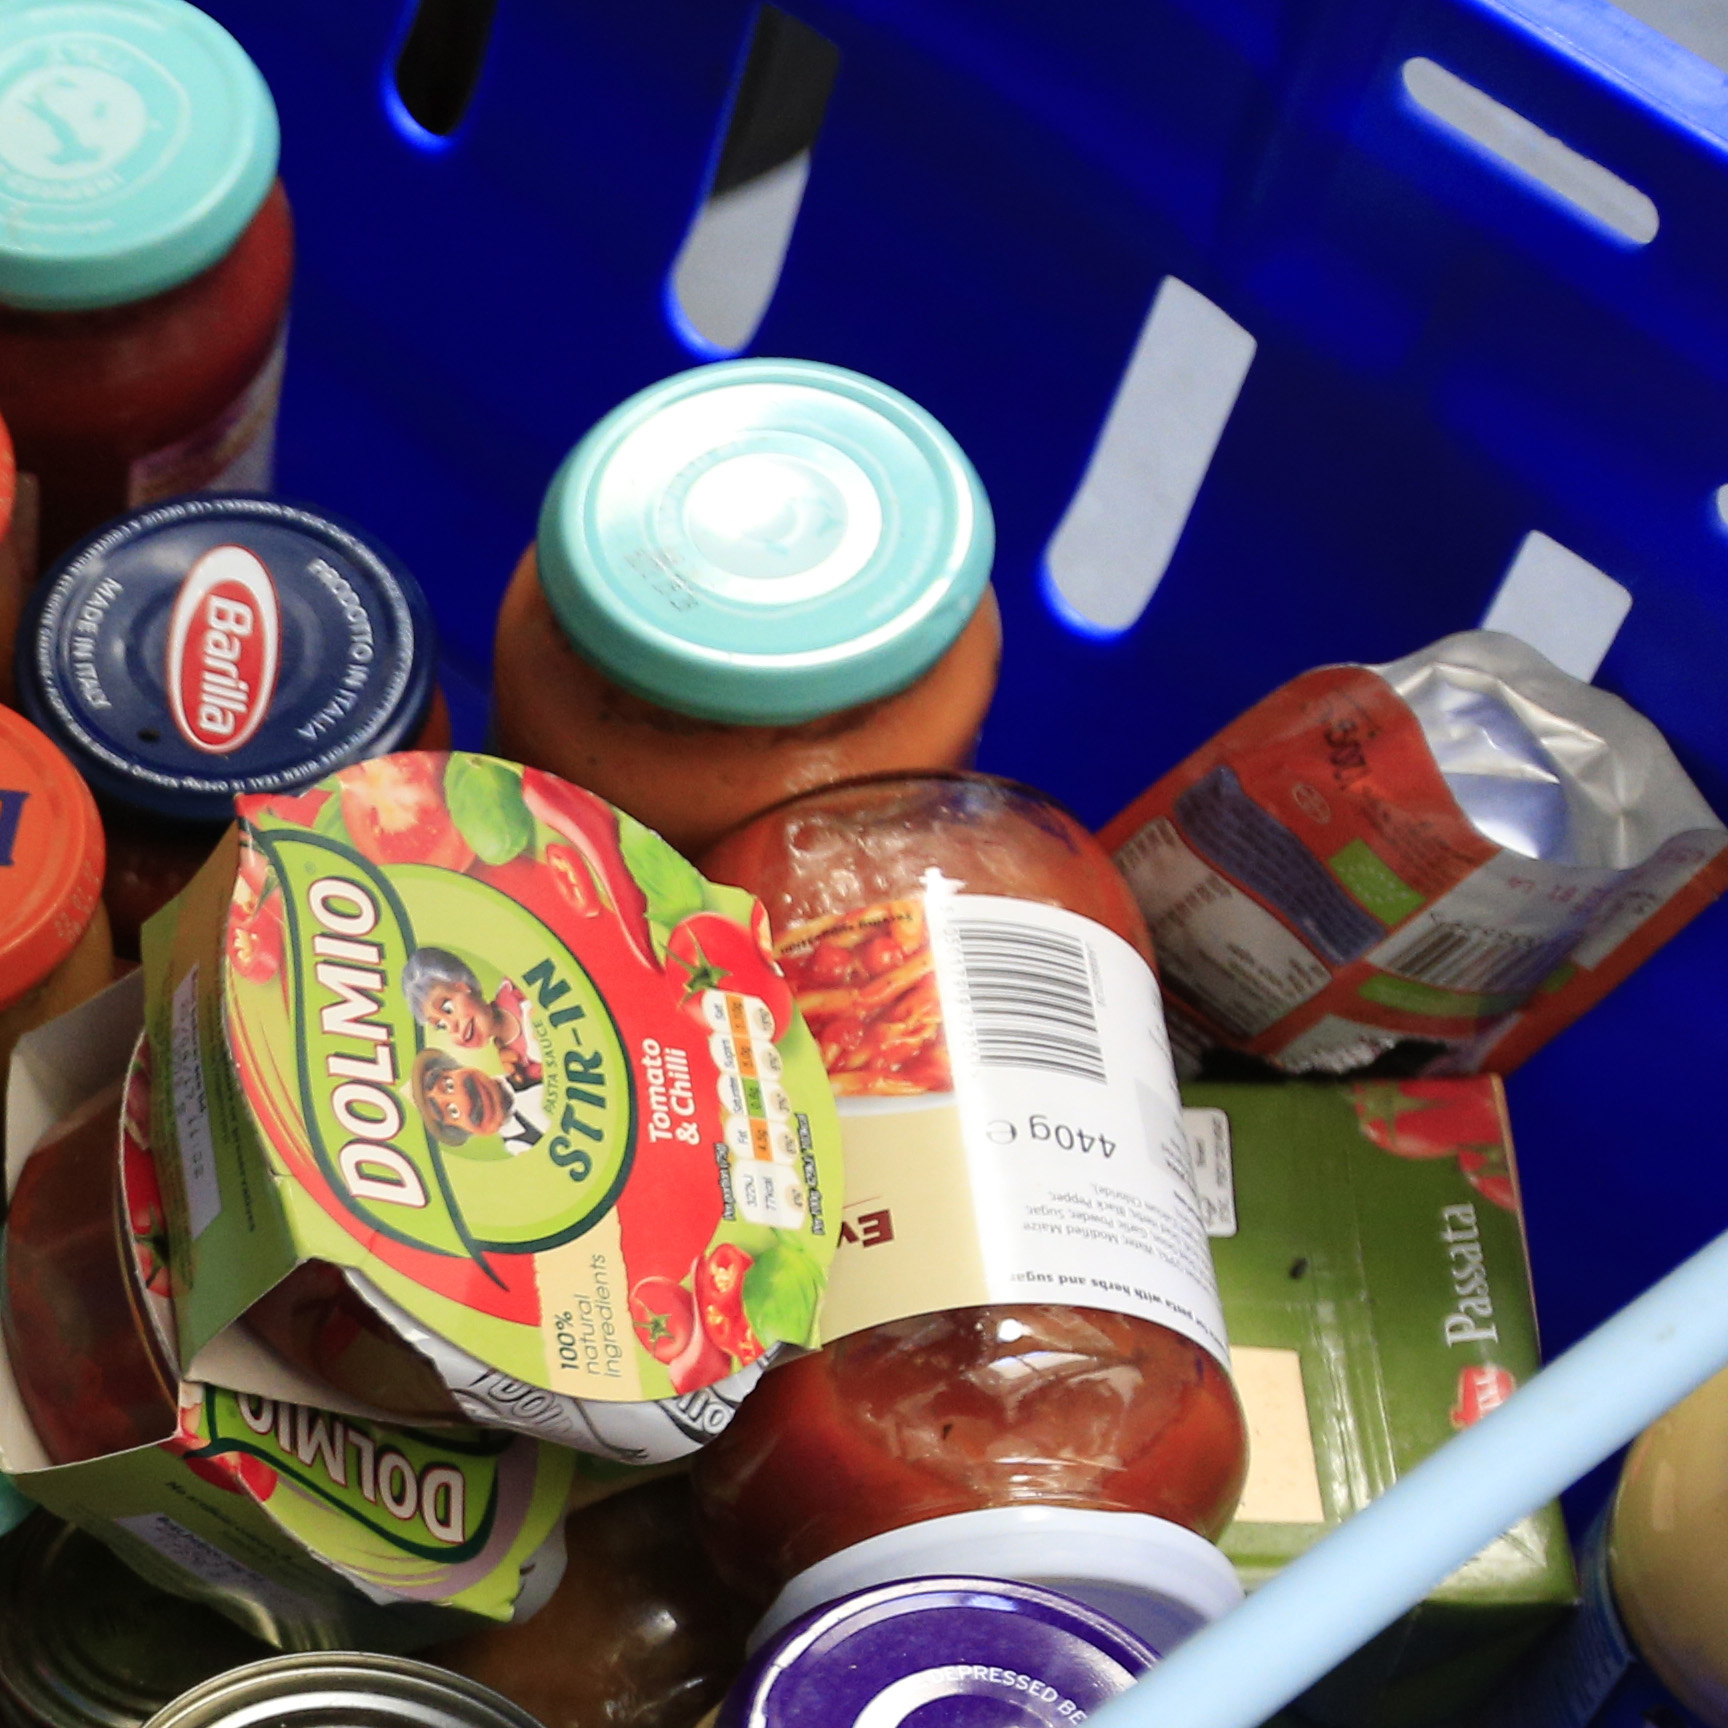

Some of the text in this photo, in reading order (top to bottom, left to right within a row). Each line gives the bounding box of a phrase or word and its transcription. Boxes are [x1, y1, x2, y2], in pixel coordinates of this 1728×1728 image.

[72, 577, 125, 711] MADE IN ITALY
[197, 593, 255, 735] Barilla
[295, 557, 376, 742] PRODOTTO IN ITALIA
[307, 875, 429, 1208] DOLMIO
[711, 1002, 726, 1021] Salt
[522, 956, 609, 1183] STIR-IN
[531, 1018, 559, 1118] PASTA SAUCE
[717, 1037, 736, 1069] Sugars
[638, 1036, 675, 1144] Tomato
[664, 1046, 700, 1146] & Chilli
[735, 1128, 749, 1145] Fat
[1026, 1101, 1118, 1171] 440g
[715, 1168, 735, 1203] portion
[740, 1173, 760, 1208] 322kJ
[759, 1176, 779, 1211] 77kcal
[1022, 1216, 1063, 1239] Maize
[1064, 1217, 1117, 1252] Modified
[1057, 1269, 1086, 1290] and
[1090, 1272, 1130, 1300] herbs
[1133, 1284, 1162, 1307] with
[1440, 1203, 1499, 1347] Passata
[557, 1307, 580, 1371] 100%
[572, 1292, 598, 1377] natural
[594, 1251, 626, 1380] ingredients
[929, 1664, 1059, 1704] DEPRESSED
